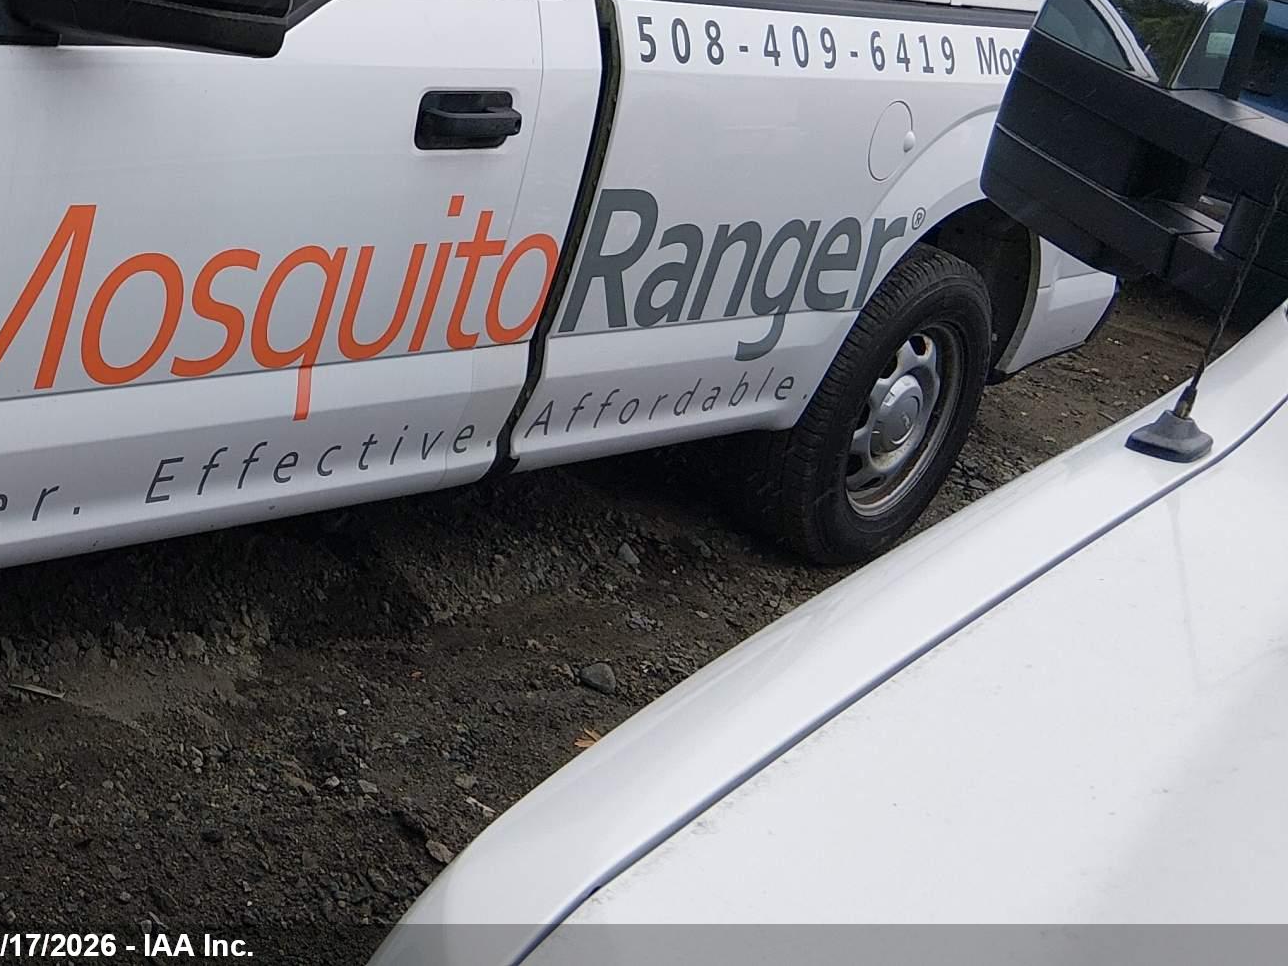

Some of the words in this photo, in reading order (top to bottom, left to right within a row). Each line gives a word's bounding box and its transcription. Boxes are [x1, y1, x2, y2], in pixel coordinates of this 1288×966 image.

[636, 16, 957, 75] 508-409-6419
[145, 423, 492, 504] Effective.
[524, 366, 810, 439] Affordable.
